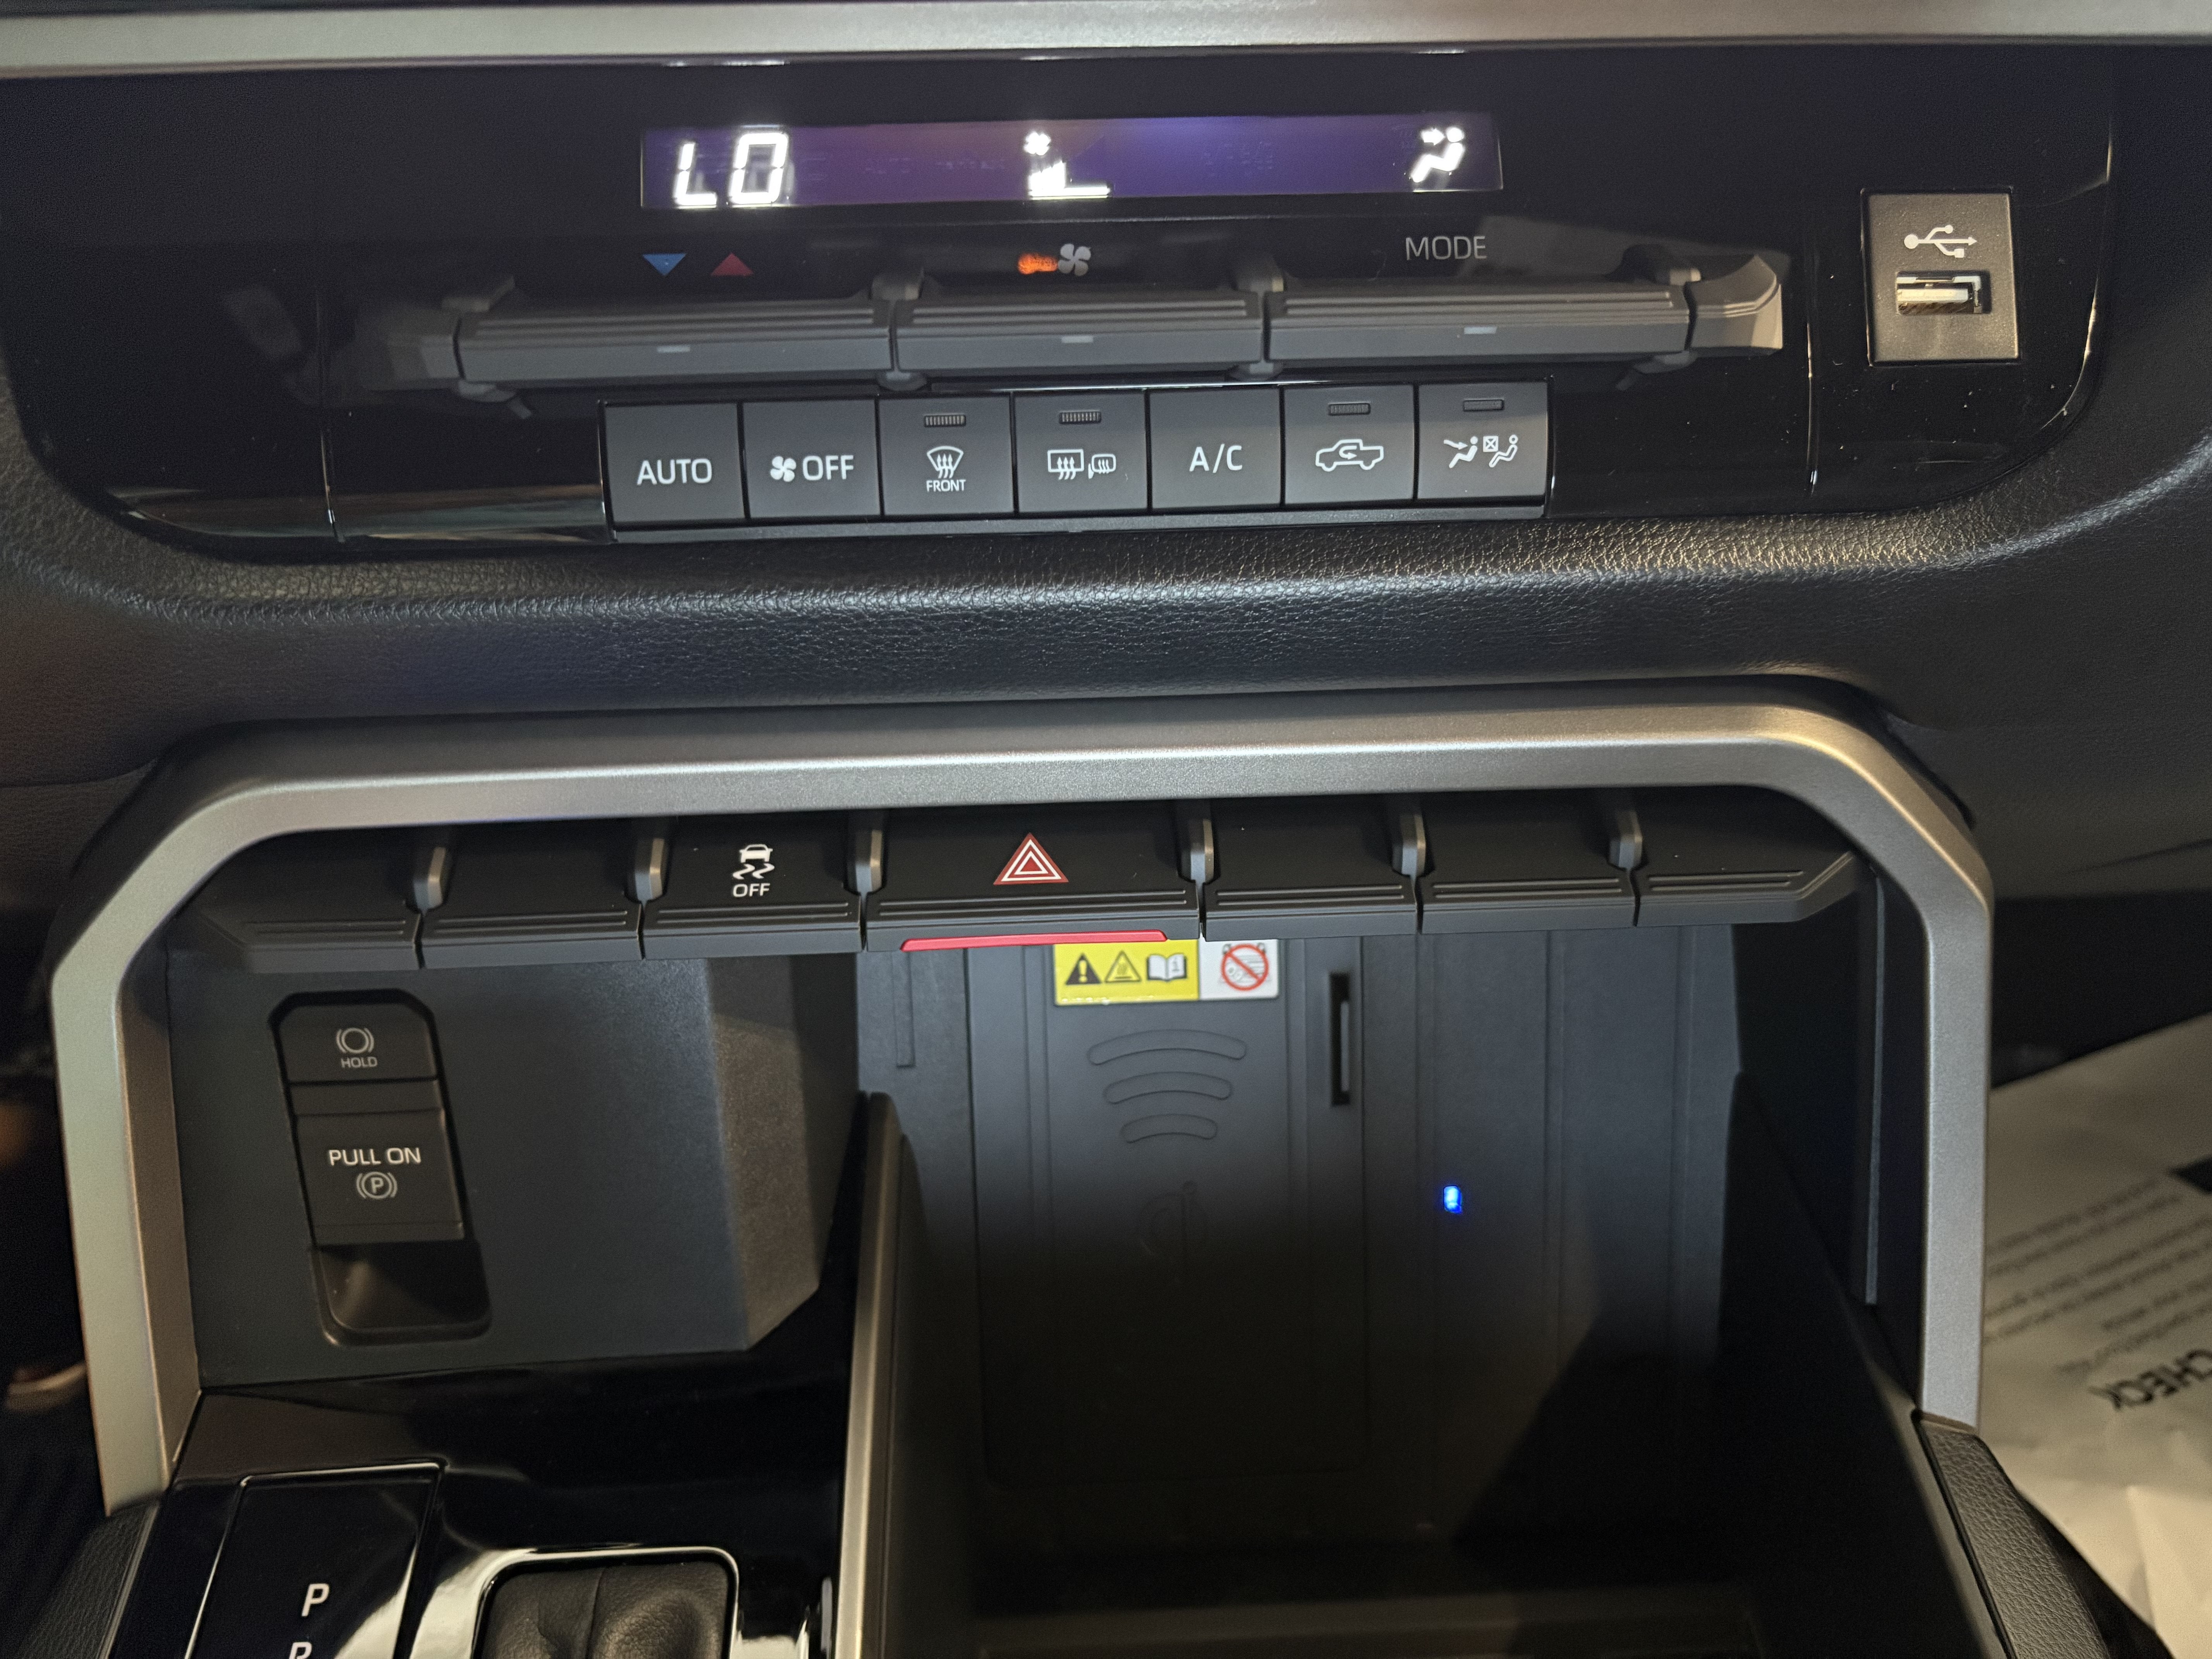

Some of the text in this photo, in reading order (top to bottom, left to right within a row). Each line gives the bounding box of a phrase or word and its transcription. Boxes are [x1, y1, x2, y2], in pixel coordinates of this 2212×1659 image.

[674, 132, 789, 208] LO
[1405, 235, 1487, 260] MODE
[802, 455, 854, 481] OFF
[1189, 443, 1243, 473] A/C
[637, 458, 712, 485] AUTO
[926, 479, 966, 492] FRONT
[732, 883, 770, 897] OFF
[341, 1056, 378, 1068] HOLD
[328, 1147, 421, 1166] PULL ON
[301, 1583, 330, 1617] P
